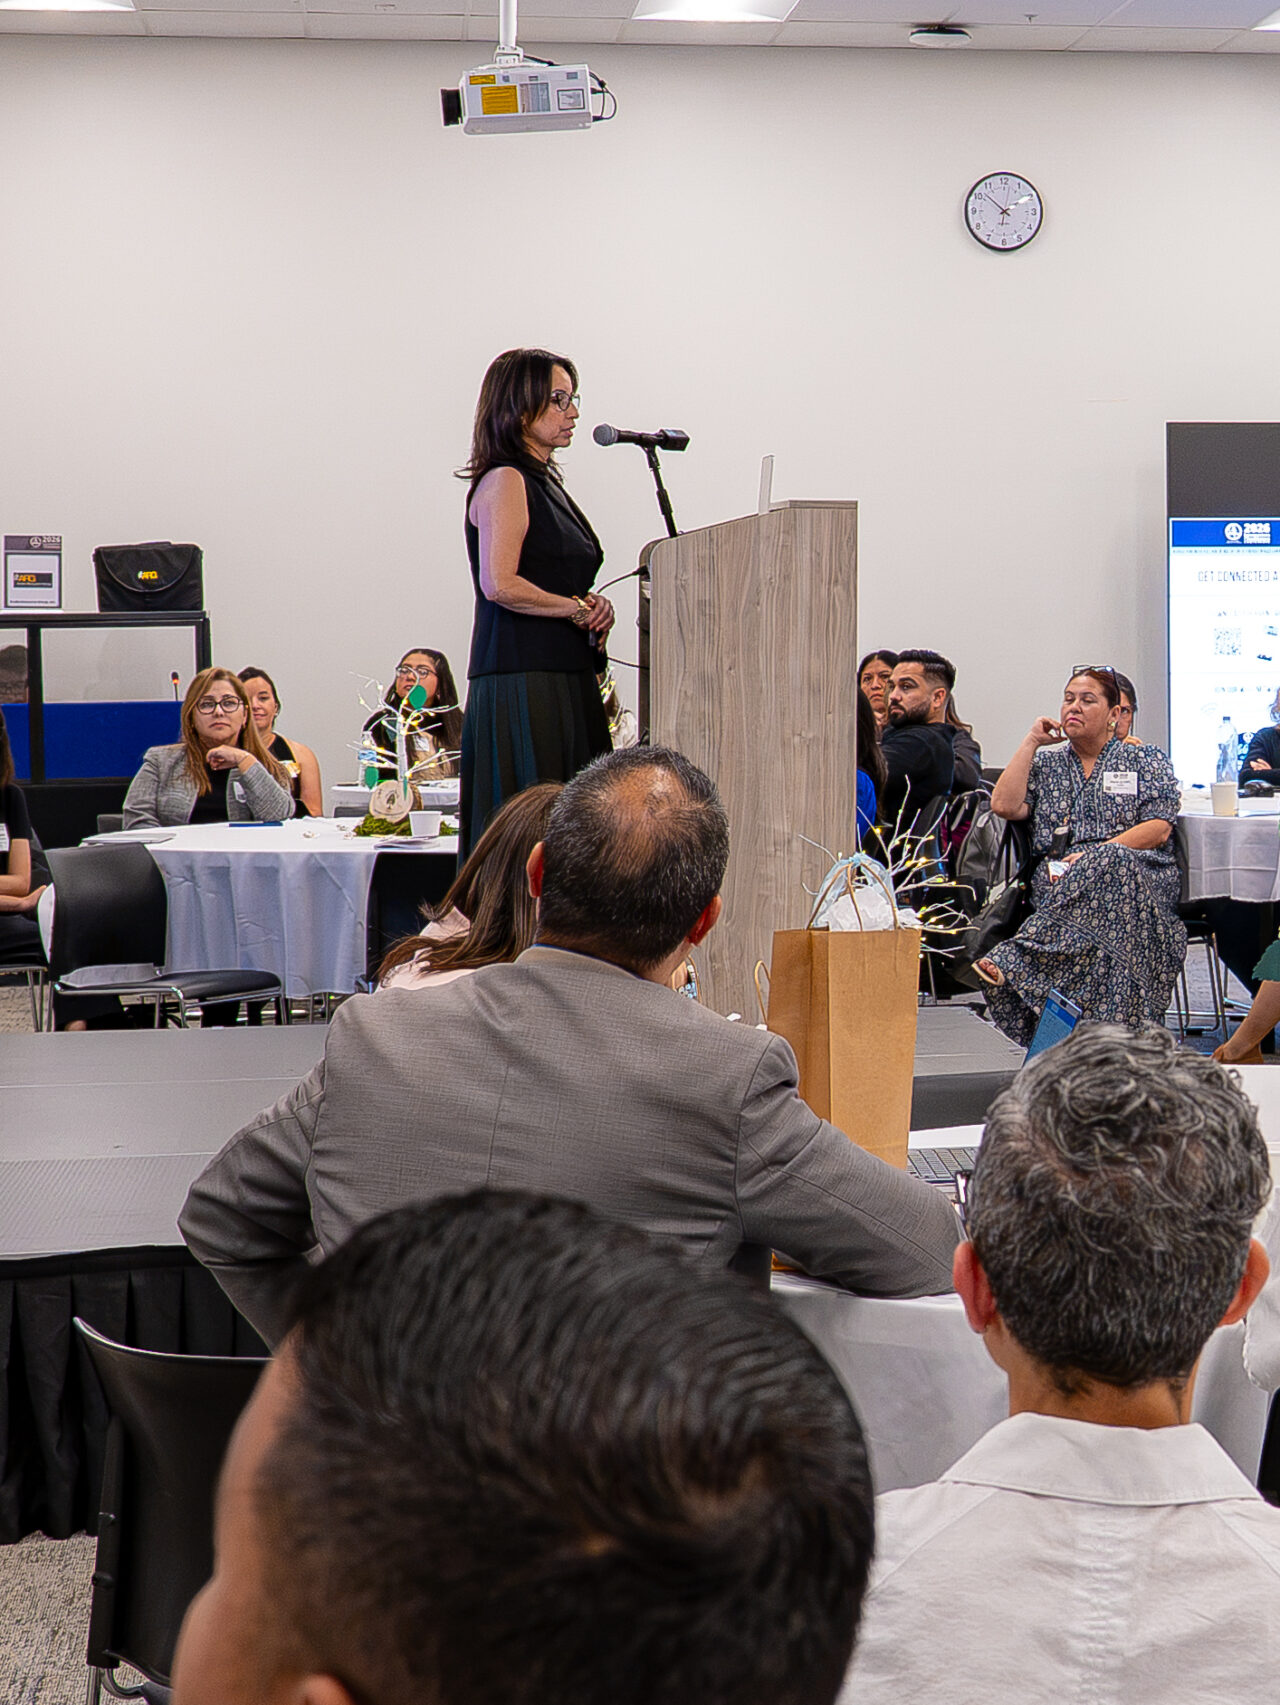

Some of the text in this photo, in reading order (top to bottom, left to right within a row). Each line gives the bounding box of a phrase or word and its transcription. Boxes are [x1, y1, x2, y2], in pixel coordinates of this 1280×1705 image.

[974, 192, 983, 200] 10
[1031, 208, 1037, 216] 3
[1001, 238, 1007, 246] 6
[1016, 234, 1023, 242] 5
[1198, 570, 1214, 582] GET
[1217, 570, 1270, 582] CONNECTED
